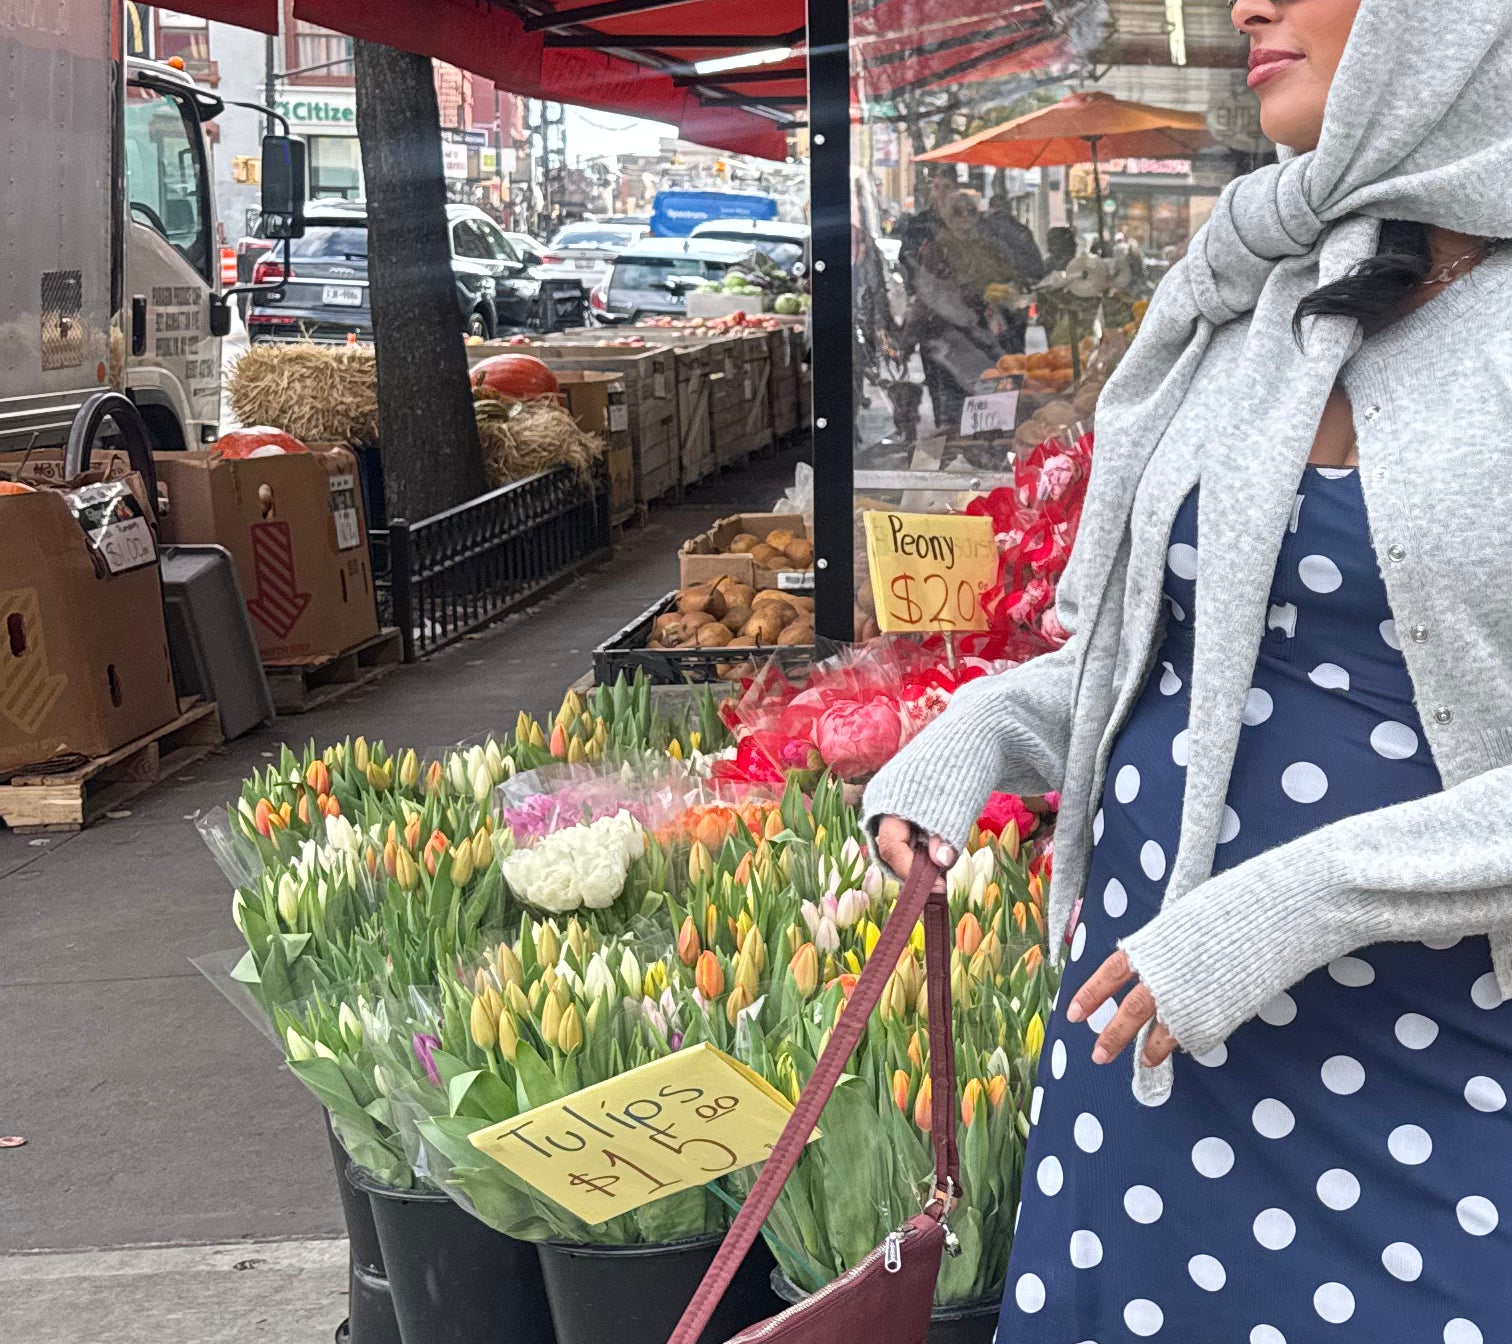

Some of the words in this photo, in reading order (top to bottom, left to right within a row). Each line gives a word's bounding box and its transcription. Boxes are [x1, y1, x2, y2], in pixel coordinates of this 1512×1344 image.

[887, 514, 955, 570] Peony
[889, 572, 976, 626] $20
[496, 1084, 705, 1158] Tulips
[567, 1122, 738, 1198] $15
